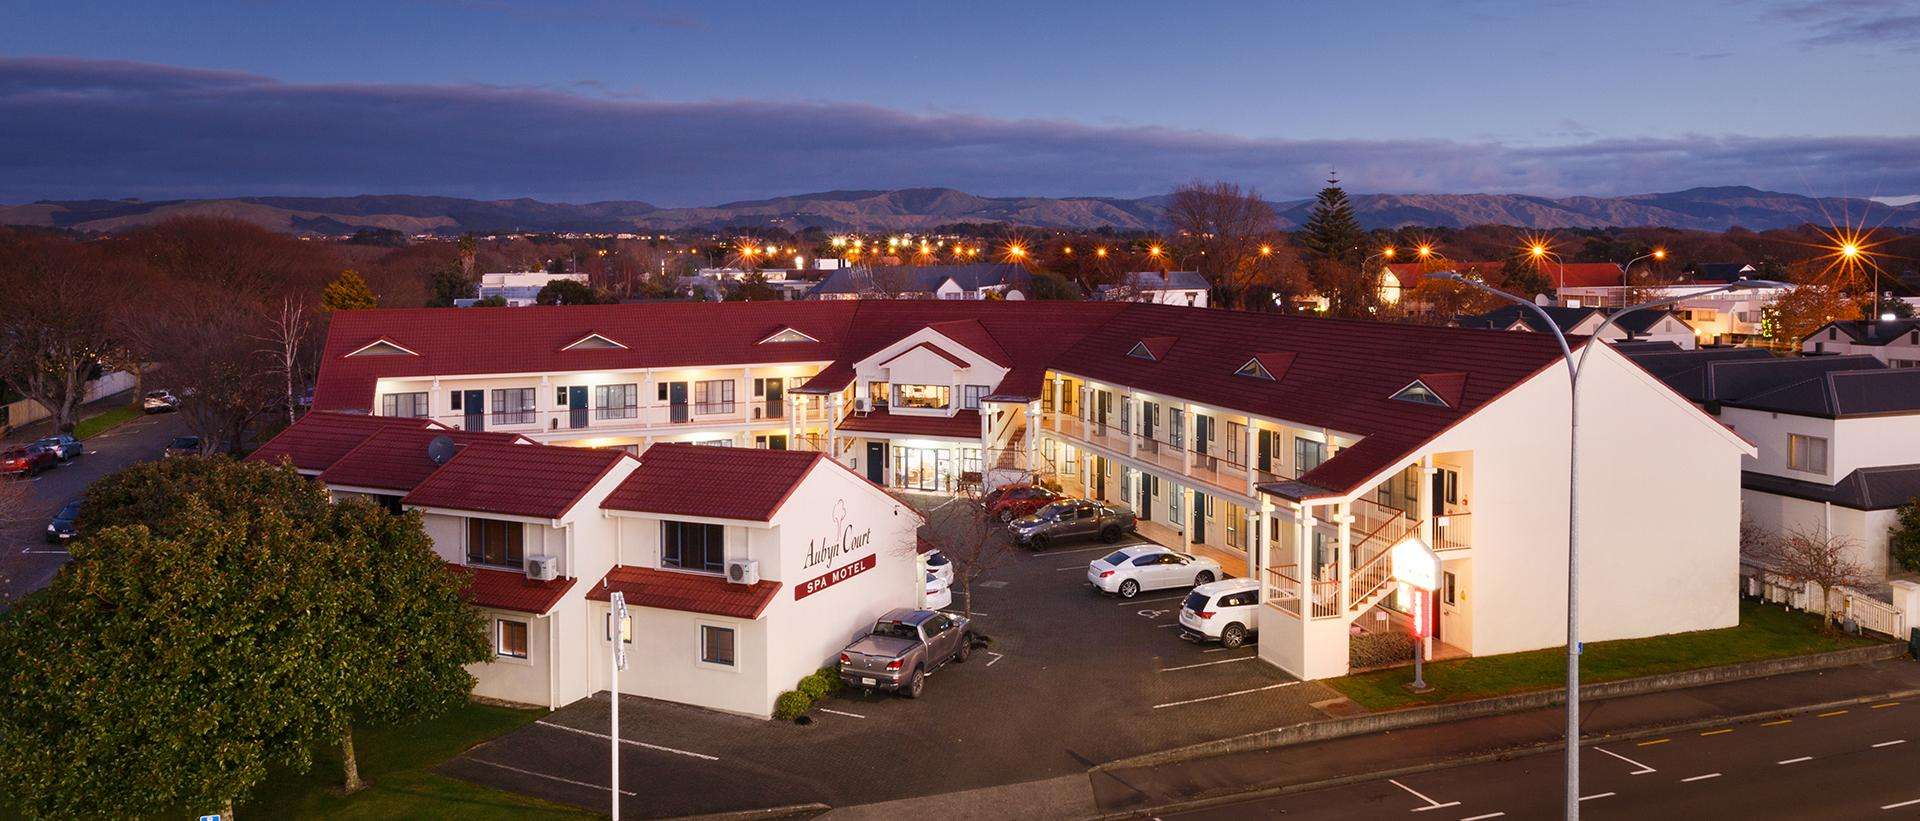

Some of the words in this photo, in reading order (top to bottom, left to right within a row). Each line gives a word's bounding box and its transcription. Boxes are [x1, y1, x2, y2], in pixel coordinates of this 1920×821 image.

[803, 537, 840, 569] Aubyn
[842, 524, 871, 553] Court
[807, 577, 827, 593] SPA
[832, 561, 866, 583] MOTEL
